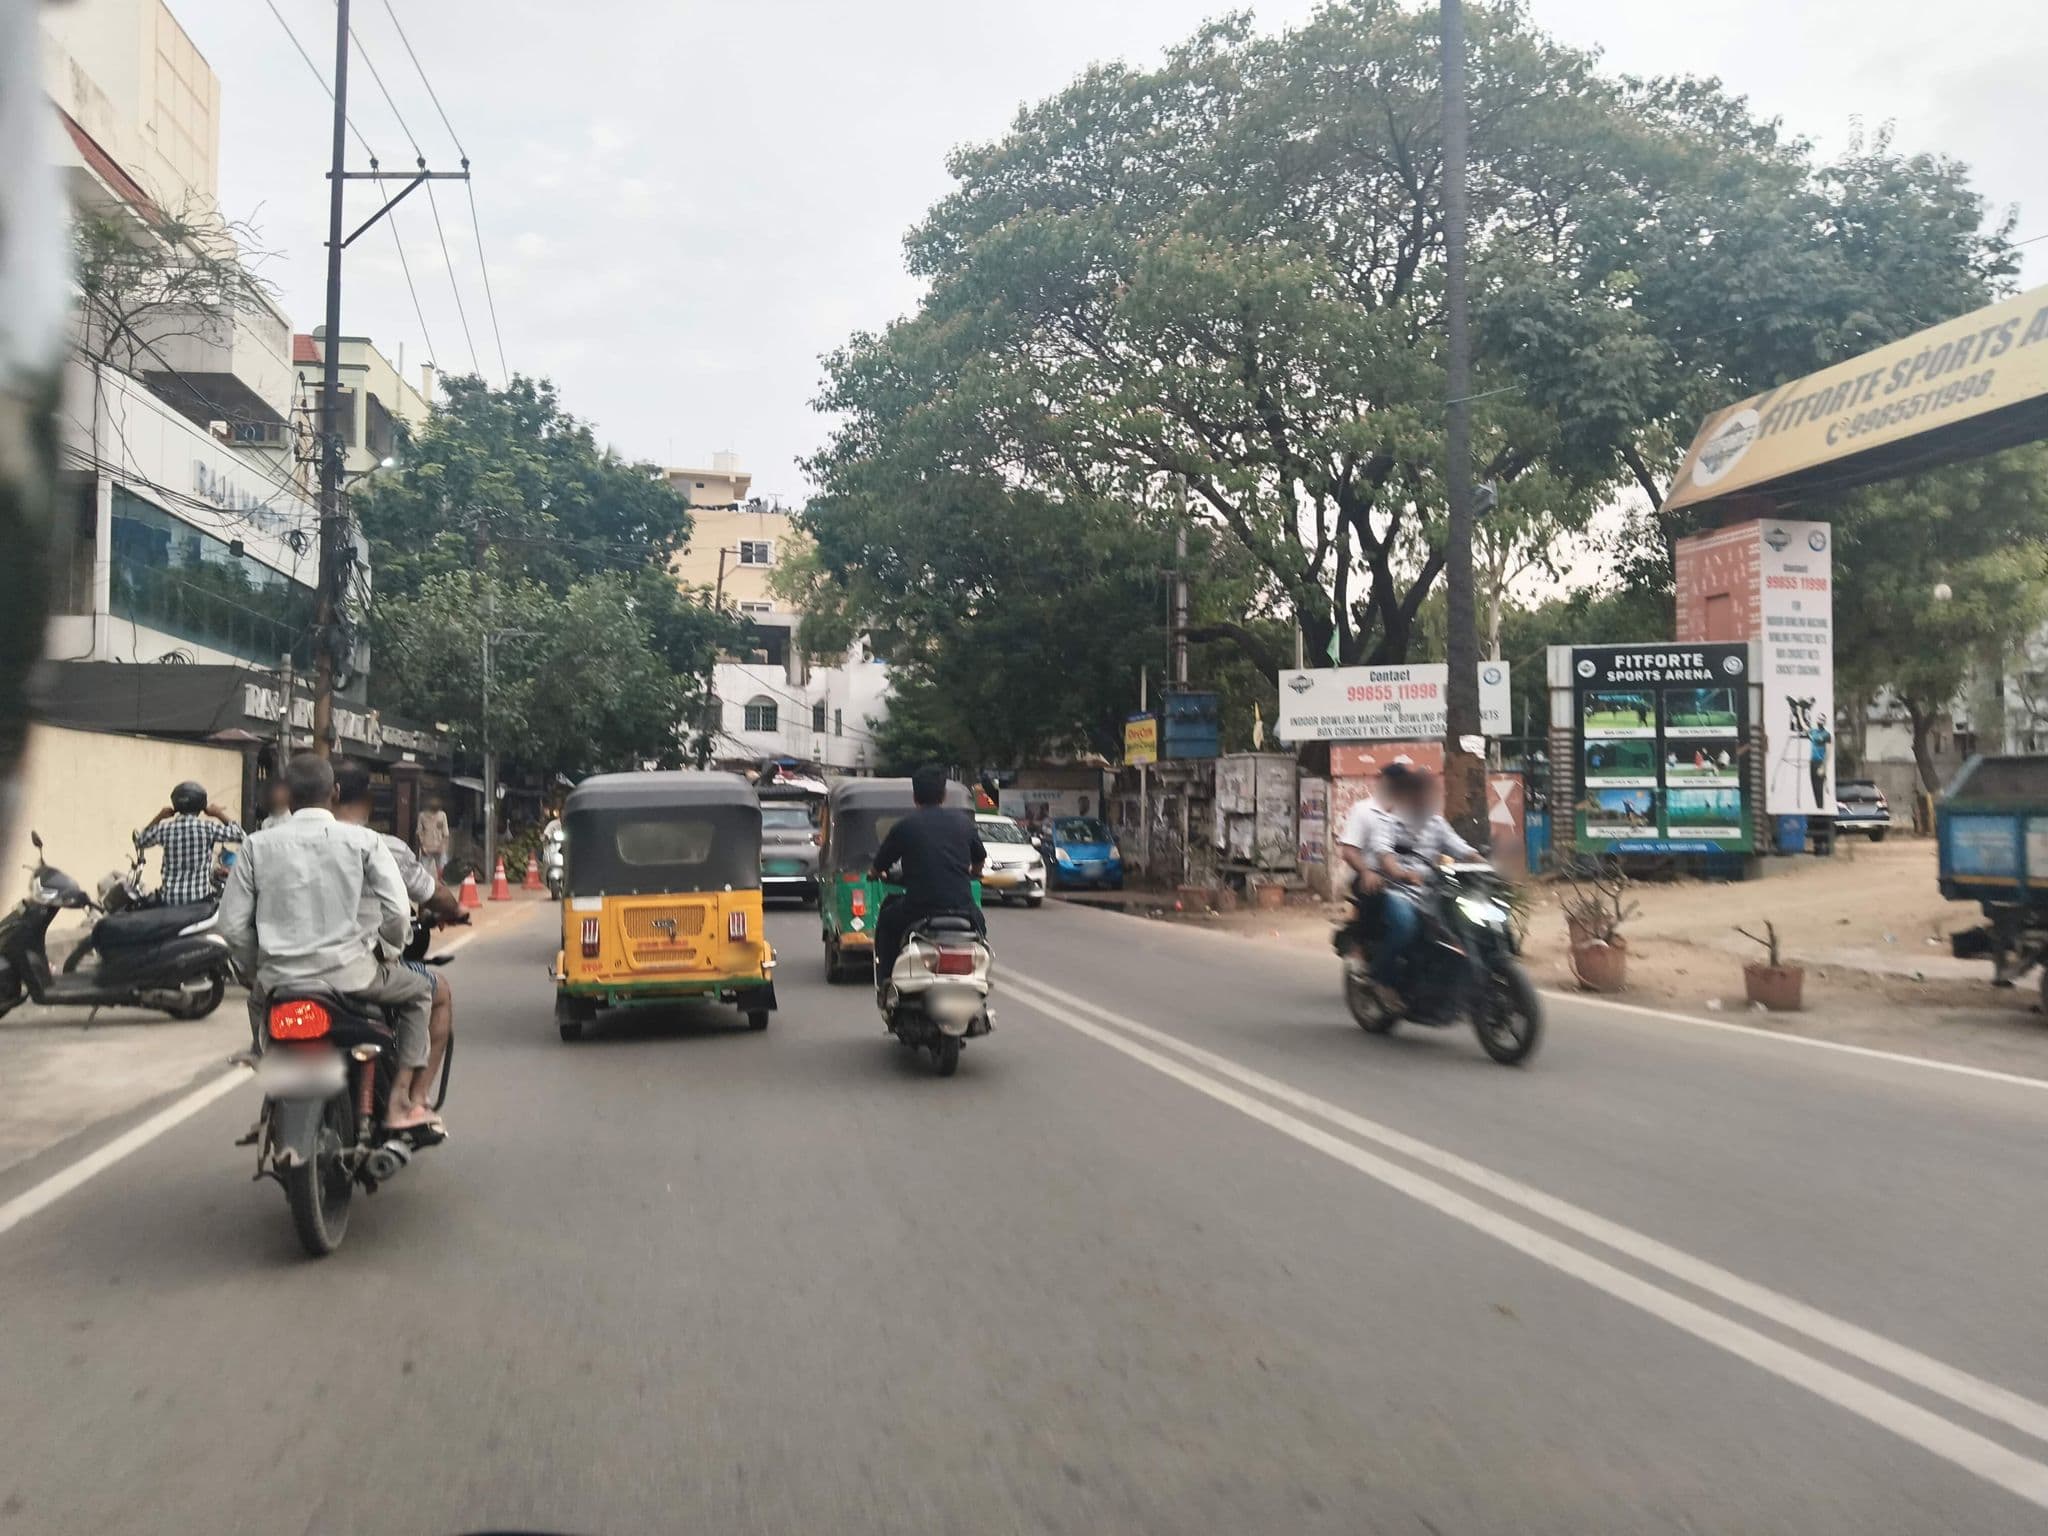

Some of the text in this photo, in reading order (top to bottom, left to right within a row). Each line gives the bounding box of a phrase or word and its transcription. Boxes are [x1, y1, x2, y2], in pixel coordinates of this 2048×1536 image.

[1757, 366, 1887, 441] FITFORTE
[1884, 316, 2022, 395] SPORTS
[1614, 652, 1705, 669] FITFORTE
[1369, 669, 1411, 683] Contact
[1606, 668, 1714, 682] SPORTS ARENA
[1347, 683, 1438, 702] 99855 11998
